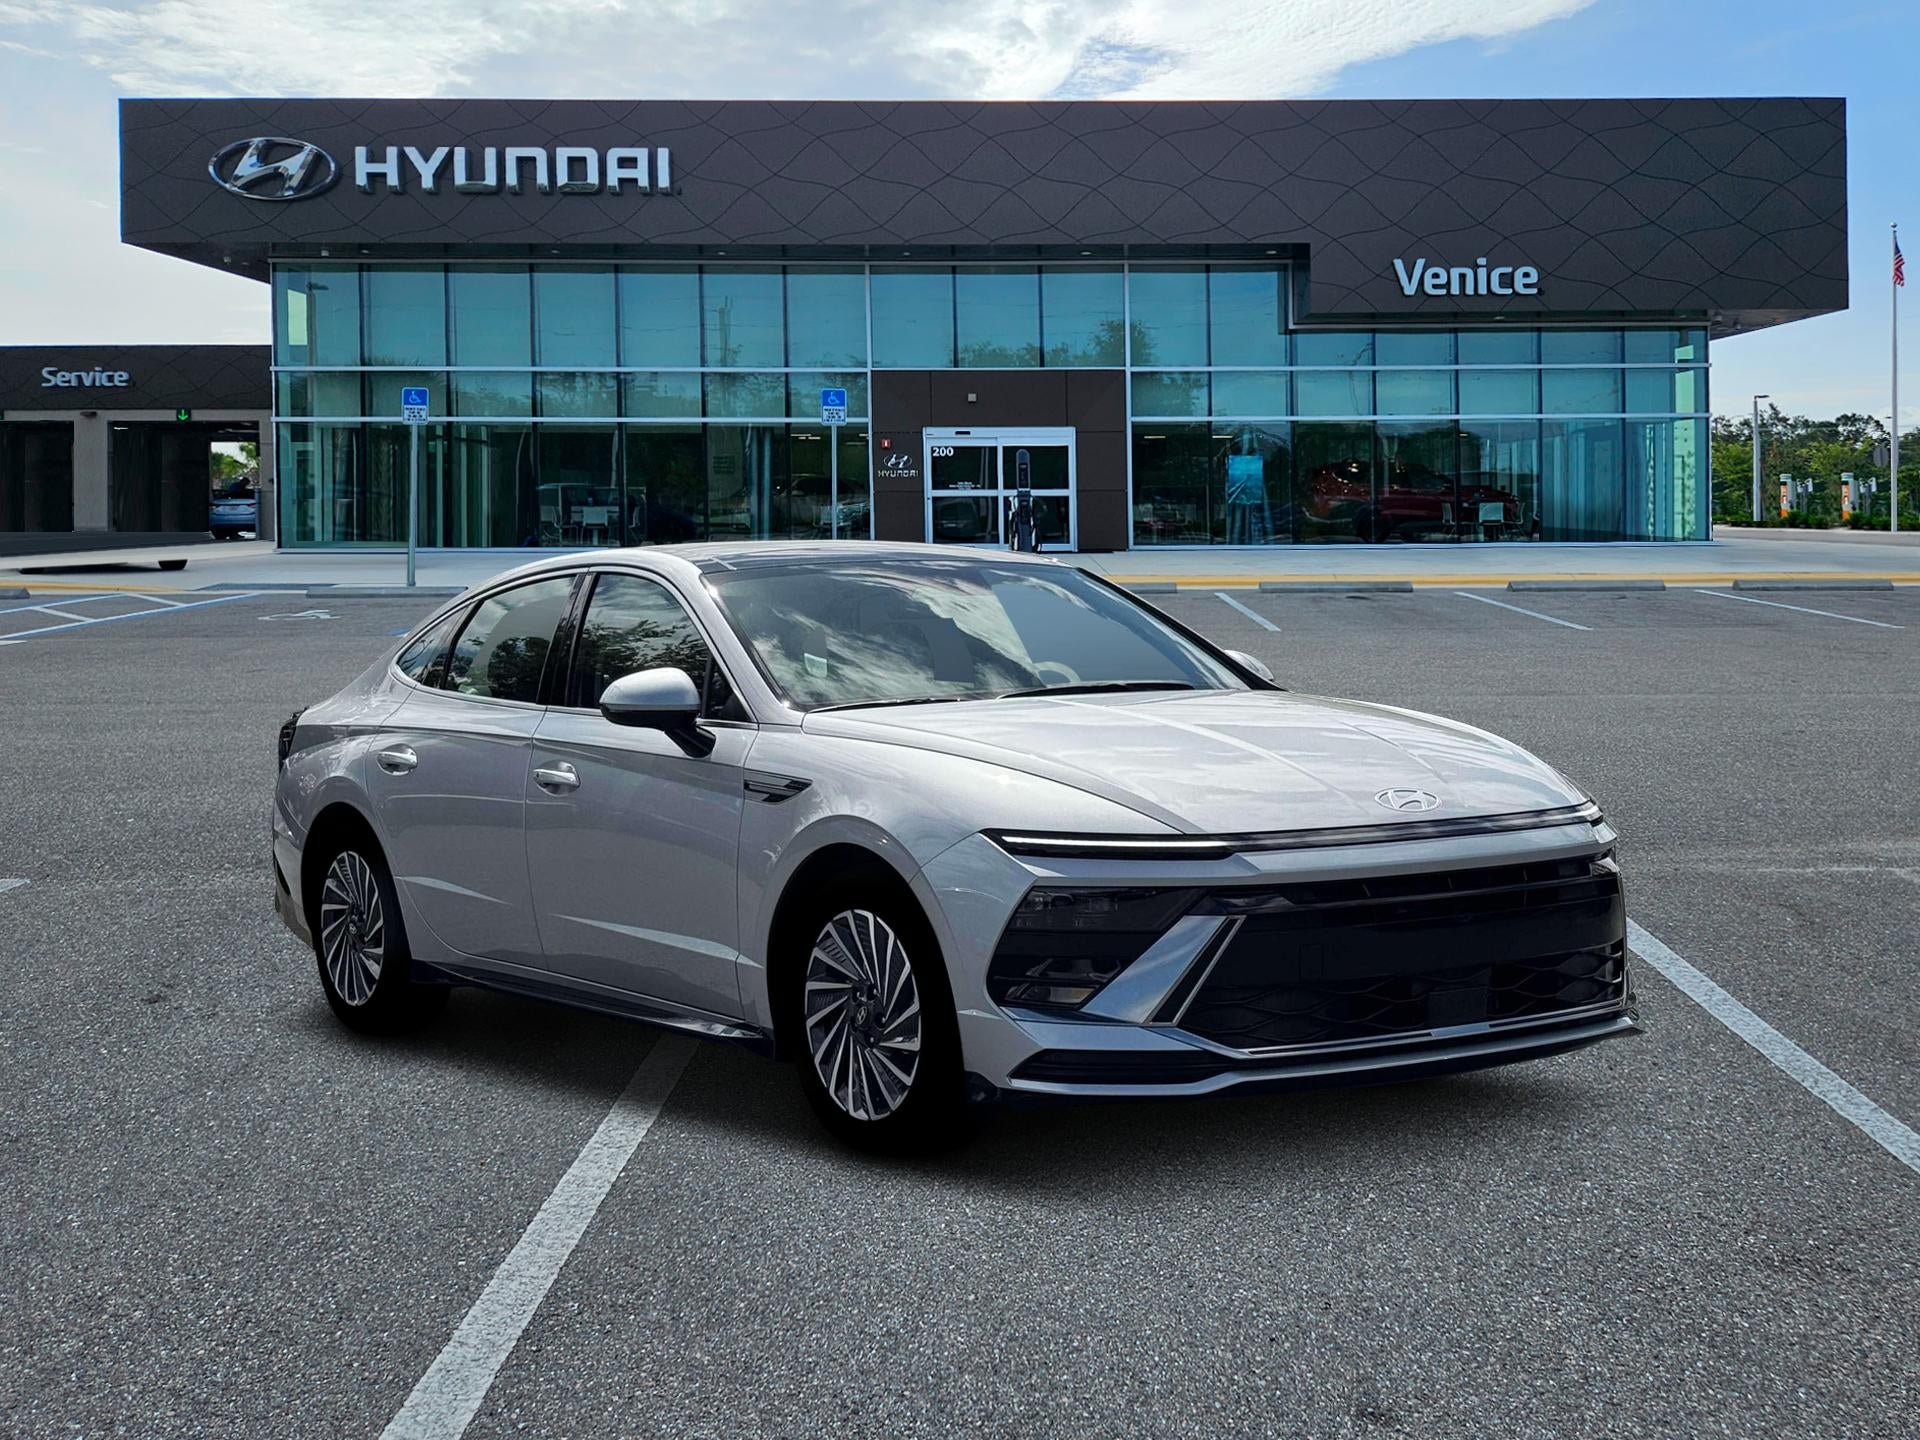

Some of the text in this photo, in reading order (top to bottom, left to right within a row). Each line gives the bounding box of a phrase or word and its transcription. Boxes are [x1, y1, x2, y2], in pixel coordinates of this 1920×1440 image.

[354, 146, 670, 194] HYUNDAI
[1392, 257, 1539, 296] Venice
[41, 366, 130, 387] Service
[932, 447, 954, 457] 200
[877, 469, 919, 478] HYUNDAI
